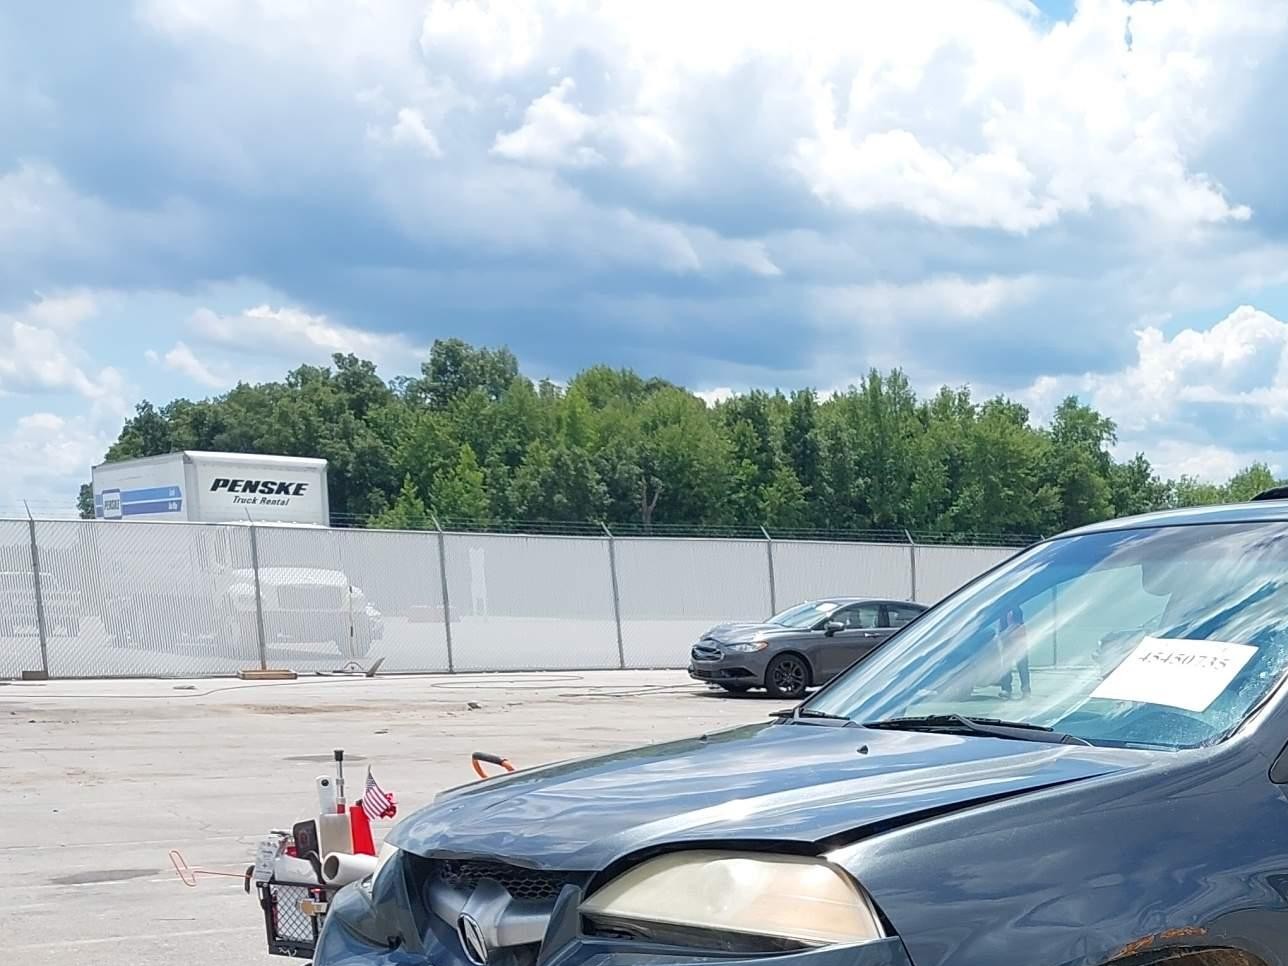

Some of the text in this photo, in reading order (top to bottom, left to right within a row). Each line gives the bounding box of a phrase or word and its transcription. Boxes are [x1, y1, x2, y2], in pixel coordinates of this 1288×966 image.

[210, 478, 309, 496] PENSKE
[233, 495, 290, 506] Truck Rental
[1138, 651, 1230, 670] 45450735
